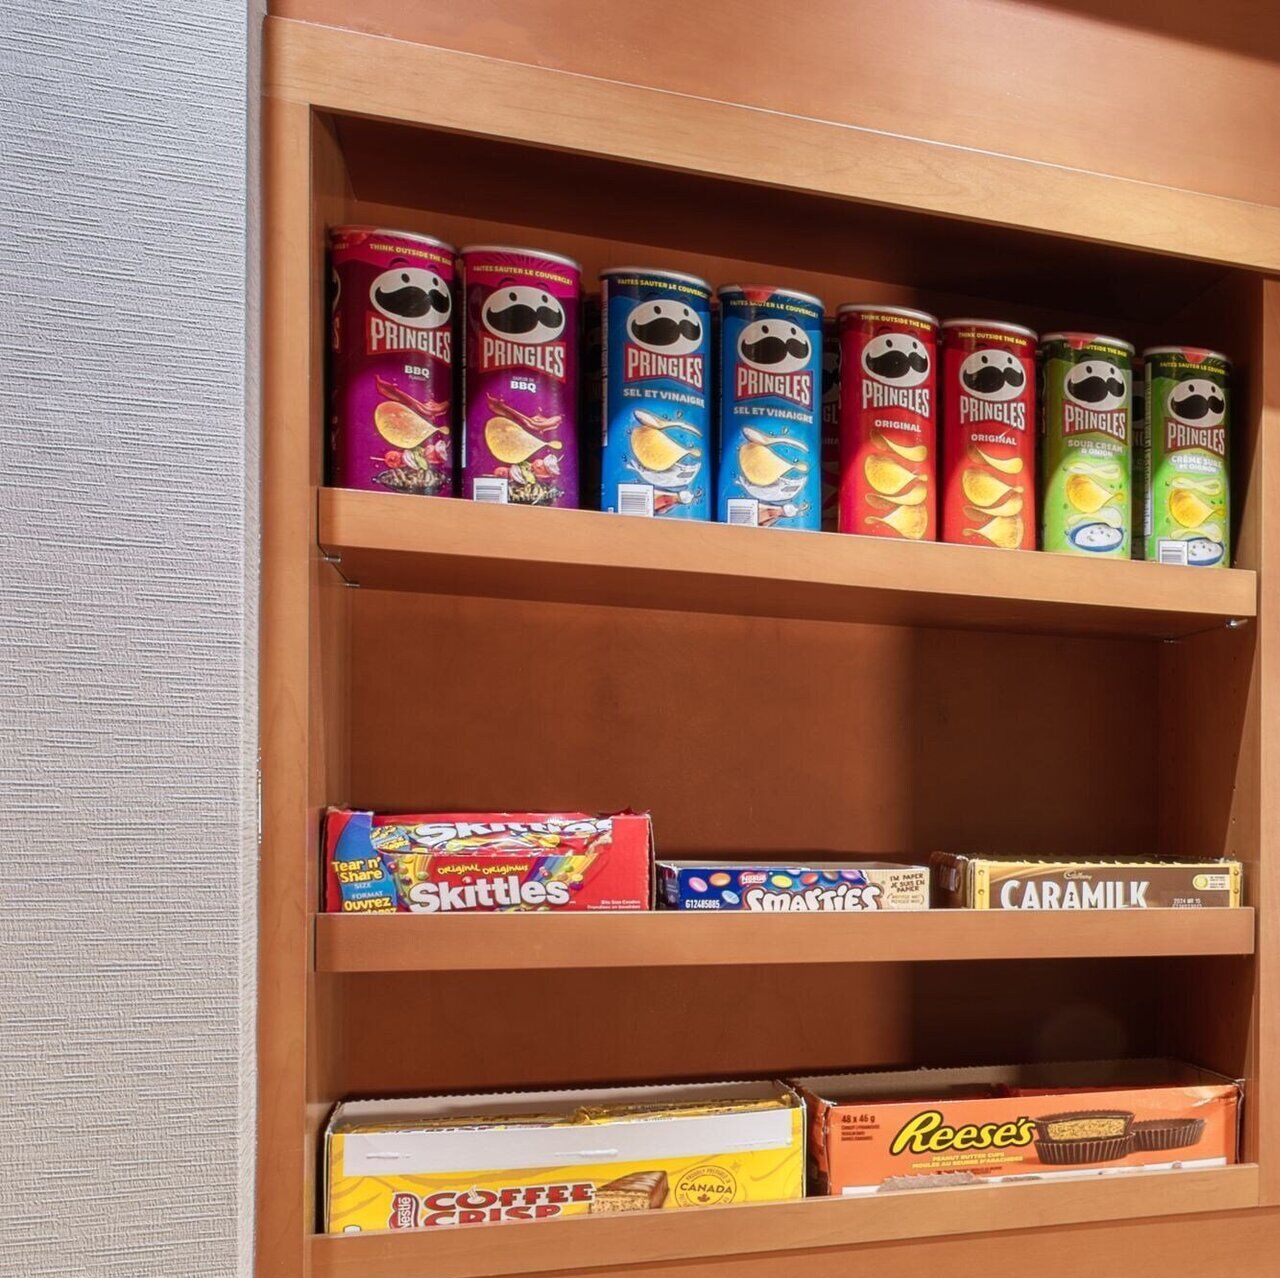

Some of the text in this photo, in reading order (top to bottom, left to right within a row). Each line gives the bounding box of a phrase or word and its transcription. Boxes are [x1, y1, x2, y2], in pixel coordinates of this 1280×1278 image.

[370, 317, 450, 364] PRINGLES
[483, 338, 564, 378] PRINGLES
[404, 364, 430, 379] BBQ
[628, 348, 703, 389] PRINGLES
[510, 381, 536, 394] BBQ
[623, 388, 642, 398] SEL
[644, 389, 658, 398] ET
[738, 366, 811, 406] PRINGLES
[862, 380, 930, 418] PRINGLES
[733, 406, 814, 424] SEL ET VINAIGRE
[960, 396, 1025, 430] PRINGLES
[1065, 404, 1126, 440] PRINGLES
[875, 420, 922, 432] ORIGINAL
[971, 433, 1018, 446] ORIGINAL
[1068, 439, 1123, 454] SOUR CREAM
[1168, 424, 1225, 456] PRINGLES
[1088, 448, 1114, 458] ONION
[331, 860, 364, 874] Tear
[340, 868, 383, 882] Share
[344, 896, 392, 911] Ouvrez
[410, 876, 570, 913] Skittles
[1000, 880, 1150, 908] CARAMILK
[841, 1115, 851, 1124] 48
[870, 1116, 876, 1124] g
[892, 1110, 1036, 1154] Reese's
[424, 1184, 596, 1211] COFFEE
[680, 1182, 733, 1194] CANADA
[424, 1204, 562, 1226] CRISP
